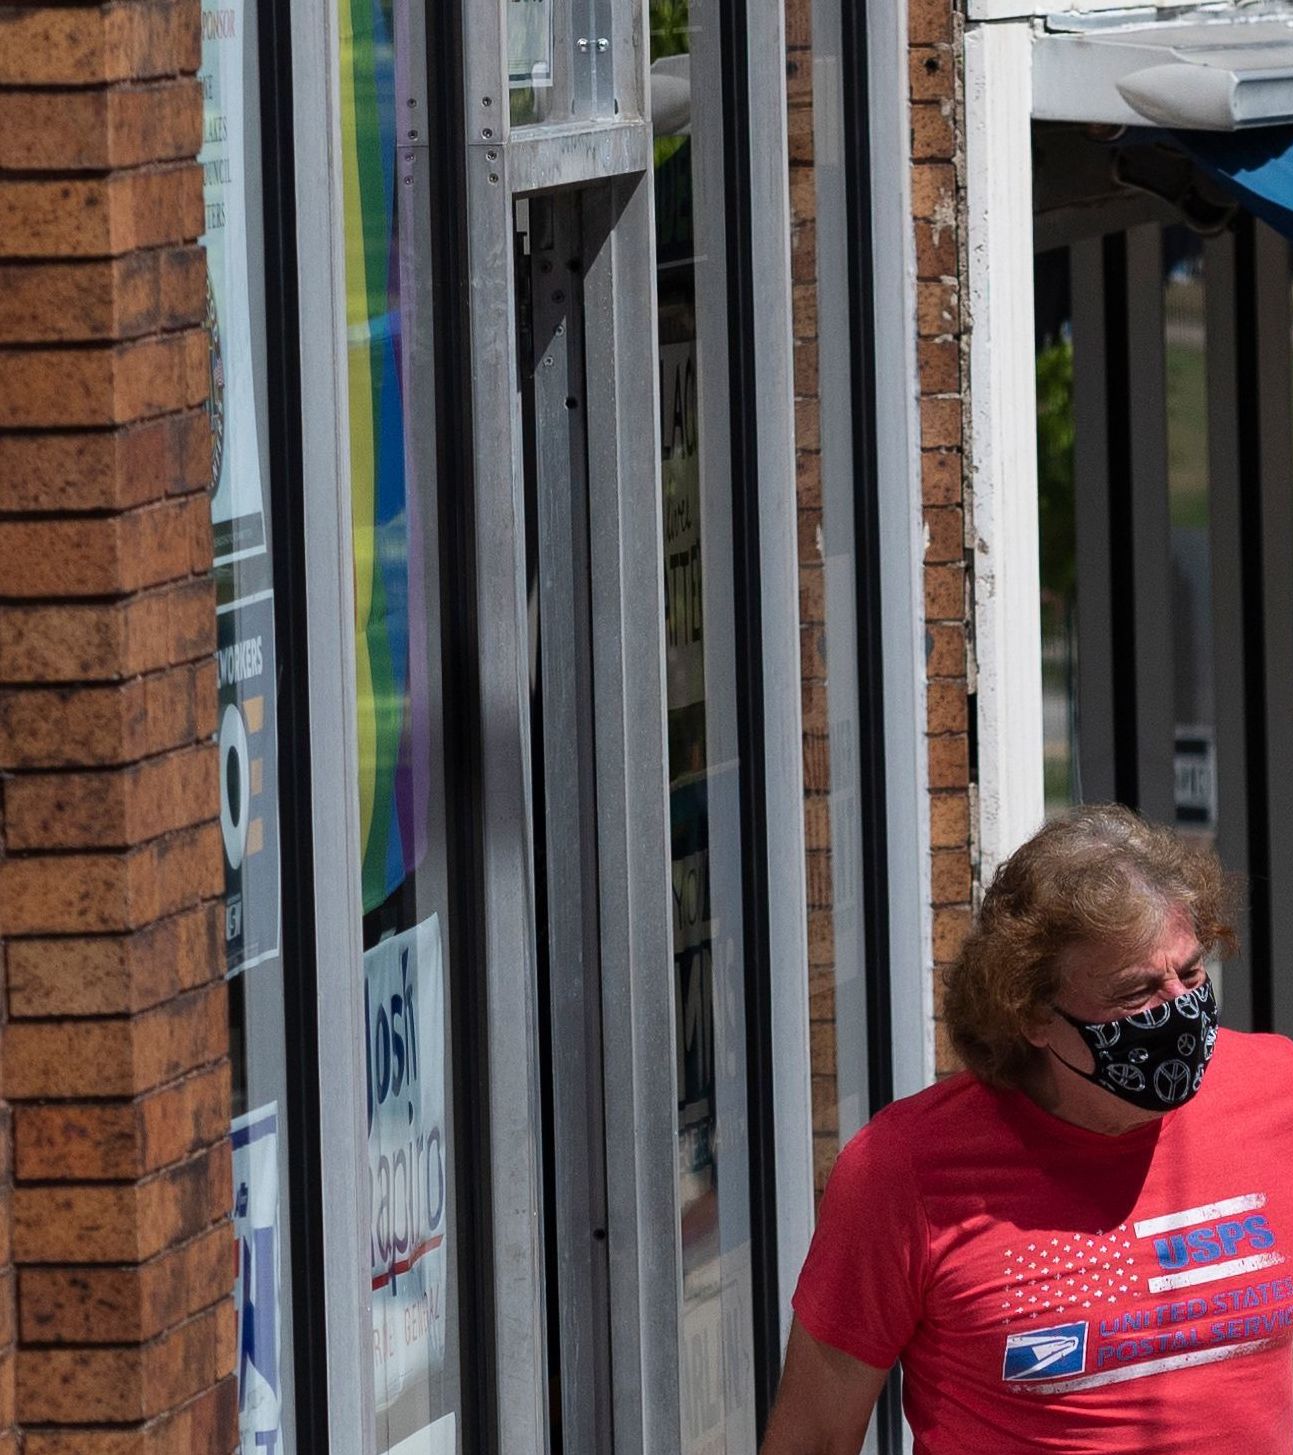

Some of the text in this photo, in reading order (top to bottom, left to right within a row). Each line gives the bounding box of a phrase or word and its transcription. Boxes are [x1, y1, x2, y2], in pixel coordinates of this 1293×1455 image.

[202, 9, 235, 40] PONSOR
[1153, 1214, 1276, 1270] USPS
[1100, 1298, 1208, 1338] UNITED
[1097, 1327, 1201, 1367] POSTAL
